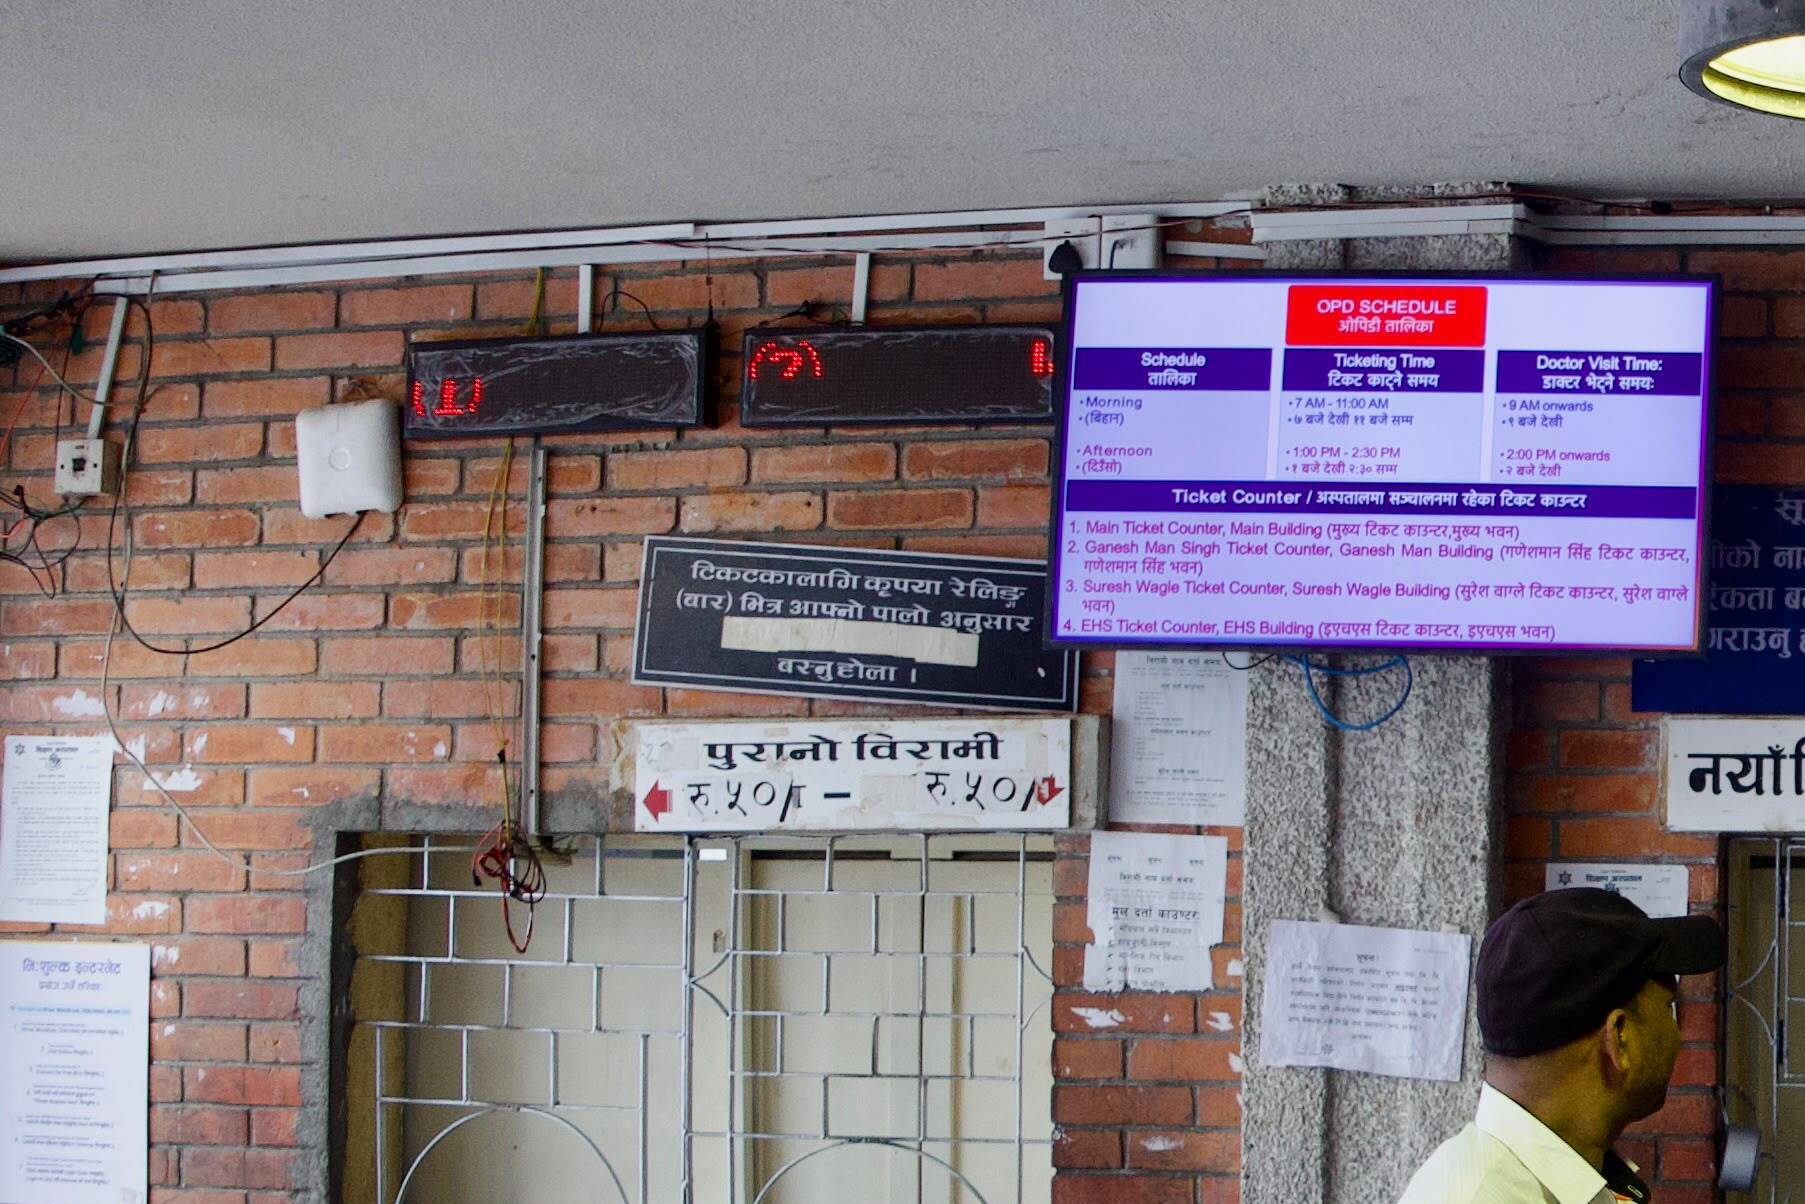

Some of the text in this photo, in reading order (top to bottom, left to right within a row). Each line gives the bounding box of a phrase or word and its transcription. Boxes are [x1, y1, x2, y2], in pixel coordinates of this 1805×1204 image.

[1317, 300, 1456, 314] OPD SCHEDULE
[1385, 316, 1434, 334] तालिका
[1141, 352, 1206, 367] Schedule
[1334, 352, 1435, 370] Ticketing Time
[1536, 355, 1663, 371] Doctor Visit Time:
[1148, 370, 1197, 387] तालिका
[1328, 370, 1363, 388] टिकट
[1407, 373, 1440, 388] समय
[1542, 374, 1581, 390] डाक्टर
[1086, 396, 1142, 410] Morning
[1295, 398, 1389, 410] 7 AM 11:00 AM
[1508, 400, 1594, 412] 9 AM onwards
[1306, 412, 1324, 426] बजे
[1369, 412, 1388, 426] बजे
[1392, 414, 1414, 426] सम्म
[1518, 415, 1536, 428] बजे
[1082, 444, 1152, 458] Afternoon
[1294, 446, 1400, 458] 1:00 PM 2:30 PM
[1506, 449, 1610, 462] 2:00 PM onwards
[1302, 460, 1320, 474] बजे
[1376, 462, 1398, 476] सम्म
[1516, 464, 1535, 477] बजे
[1172, 488, 1227, 504] Ticket
[1232, 490, 1301, 504] Counter
[1316, 490, 1384, 506] अस्पतालमा
[1462, 488, 1496, 507] रहेका
[1500, 488, 1536, 508] टिकट
[1540, 494, 1587, 508] काउन्टर
[1070, 522, 1080, 534] 1.
[1086, 520, 1119, 534] Main
[1124, 520, 1164, 534] Ticket
[1167, 521, 1226, 538] Counter,
[1230, 522, 1264, 535] Main
[1268, 522, 1322, 539] Building
[1365, 520, 1399, 537] टिकट
[1068, 540, 1079, 554] 2.
[1085, 540, 1138, 554] Ganesh
[1145, 541, 1175, 554] Man
[1182, 542, 1220, 558] Singh
[1226, 542, 1268, 555] Ticket
[1274, 542, 1333, 558] Counter,
[1340, 543, 1394, 557] Ganesh
[1402, 544, 1432, 557] Man
[1438, 544, 1494, 562] Building
[1598, 544, 1634, 560] टिकट
[1170, 560, 1204, 577] भवन)
[863, 575, 943, 599] कृपया
[1066, 580, 1078, 593] 3.
[1083, 580, 1131, 594] Suresh
[1136, 580, 1180, 597] Wagle
[1184, 580, 1224, 594] Ticket
[1229, 581, 1288, 598] Counter,
[1292, 582, 1342, 596] Suresh
[1346, 582, 1391, 600] Wagle
[1396, 584, 1450, 601] Building
[1530, 582, 1564, 599] टिकट
[740, 590, 783, 614] भित्र
[789, 596, 866, 622] आफ्नो
[872, 602, 931, 626] पालो
[939, 611, 1034, 634] अनुसार
[1082, 600, 1115, 616] भवन)
[1064, 619, 1076, 632] 4.
[1081, 620, 1112, 632] EHS
[1116, 620, 1158, 633] Ticket
[1161, 620, 1220, 636] Counter,
[1224, 621, 1256, 634] EHS
[1260, 621, 1314, 638] Building
[1376, 620, 1409, 636] टिकट
[1520, 625, 1555, 642] भवन)
[704, 734, 840, 770] पुरानो
[1687, 743, 1790, 797] नयाँ
